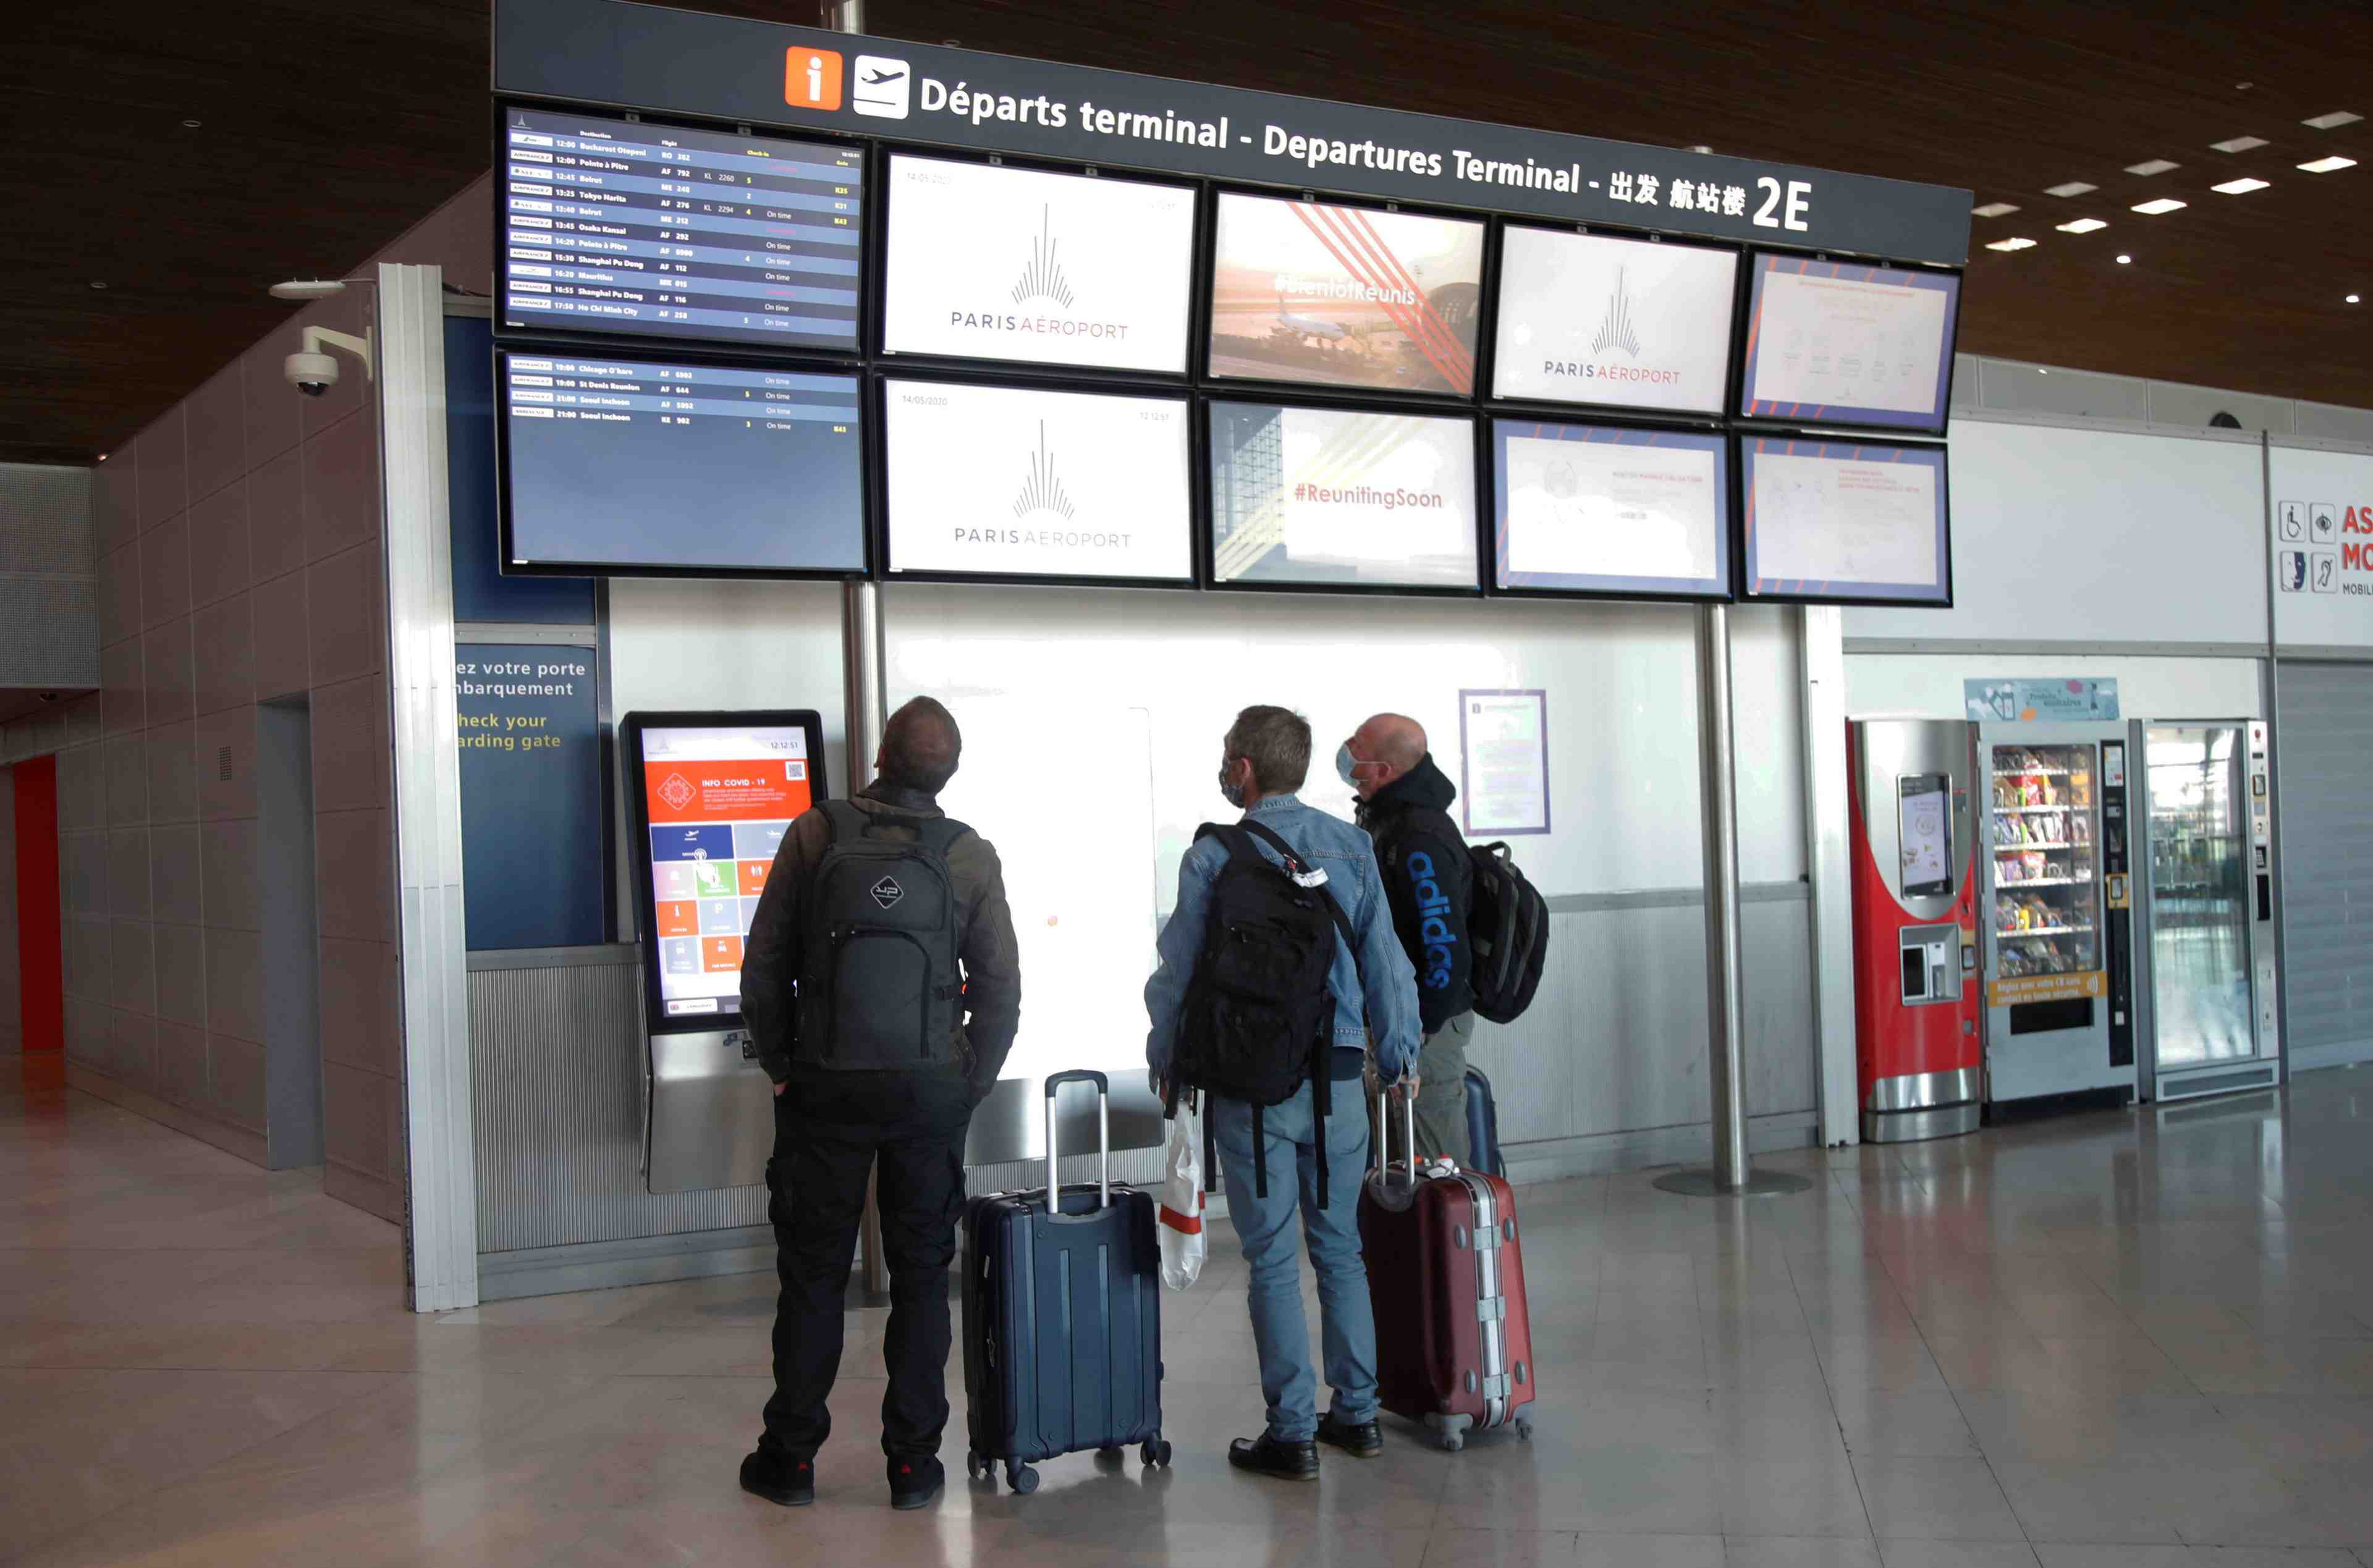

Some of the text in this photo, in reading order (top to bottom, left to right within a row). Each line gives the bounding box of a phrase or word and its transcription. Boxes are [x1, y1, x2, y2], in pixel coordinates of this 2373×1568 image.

[921, 78, 1580, 193] Départs terminal Departures Terminal
[556, 140, 575, 148] 12:00
[617, 146, 646, 156] Otopeni
[580, 159, 603, 168] Pointe
[612, 162, 628, 171] Pitre
[580, 175, 602, 184] Beirut
[556, 189, 575, 197] 13:25
[580, 192, 602, 201] Tokyo
[604, 194, 627, 203] Narita
[1609, 171, 1660, 206] 出发
[556, 205, 575, 213] 13:40
[580, 208, 602, 216] Beirut
[1753, 177, 1812, 232] 2E
[556, 221, 575, 230] 13:45
[579, 224, 601, 232] Osaka
[603, 226, 626, 235] Kansai
[777, 242, 791, 250] time
[556, 238, 574, 246] 14:20
[578, 256, 611, 266] Shanghai
[624, 261, 643, 269] Dong
[555, 270, 573, 278] 16:20
[578, 272, 613, 282] Mauritius
[578, 288, 611, 298] Shanghai
[624, 292, 643, 301] Dong
[776, 304, 789, 312] time
[555, 302, 573, 310] 17:50
[624, 308, 638, 316] City
[950, 311, 1128, 340] PARIS AÉROPORT
[579, 365, 607, 374] Chicago
[1544, 360, 1680, 384] PARIS AÉROPORT
[580, 396, 600, 404] Seoul
[602, 398, 630, 406] Incheon
[581, 411, 600, 420] Seoul
[602, 413, 630, 421] Incheon
[1295, 482, 1442, 509] #ReunitingSoon
[954, 527, 1020, 544] PARIS
[456, 662, 586, 678] ez votre porte
[459, 712, 547, 731] heck your
[458, 733, 560, 751] arding gate
[724, 778, 750, 786] COVID
[757, 778, 766, 786] 19
[1406, 851, 1457, 989] adidas
